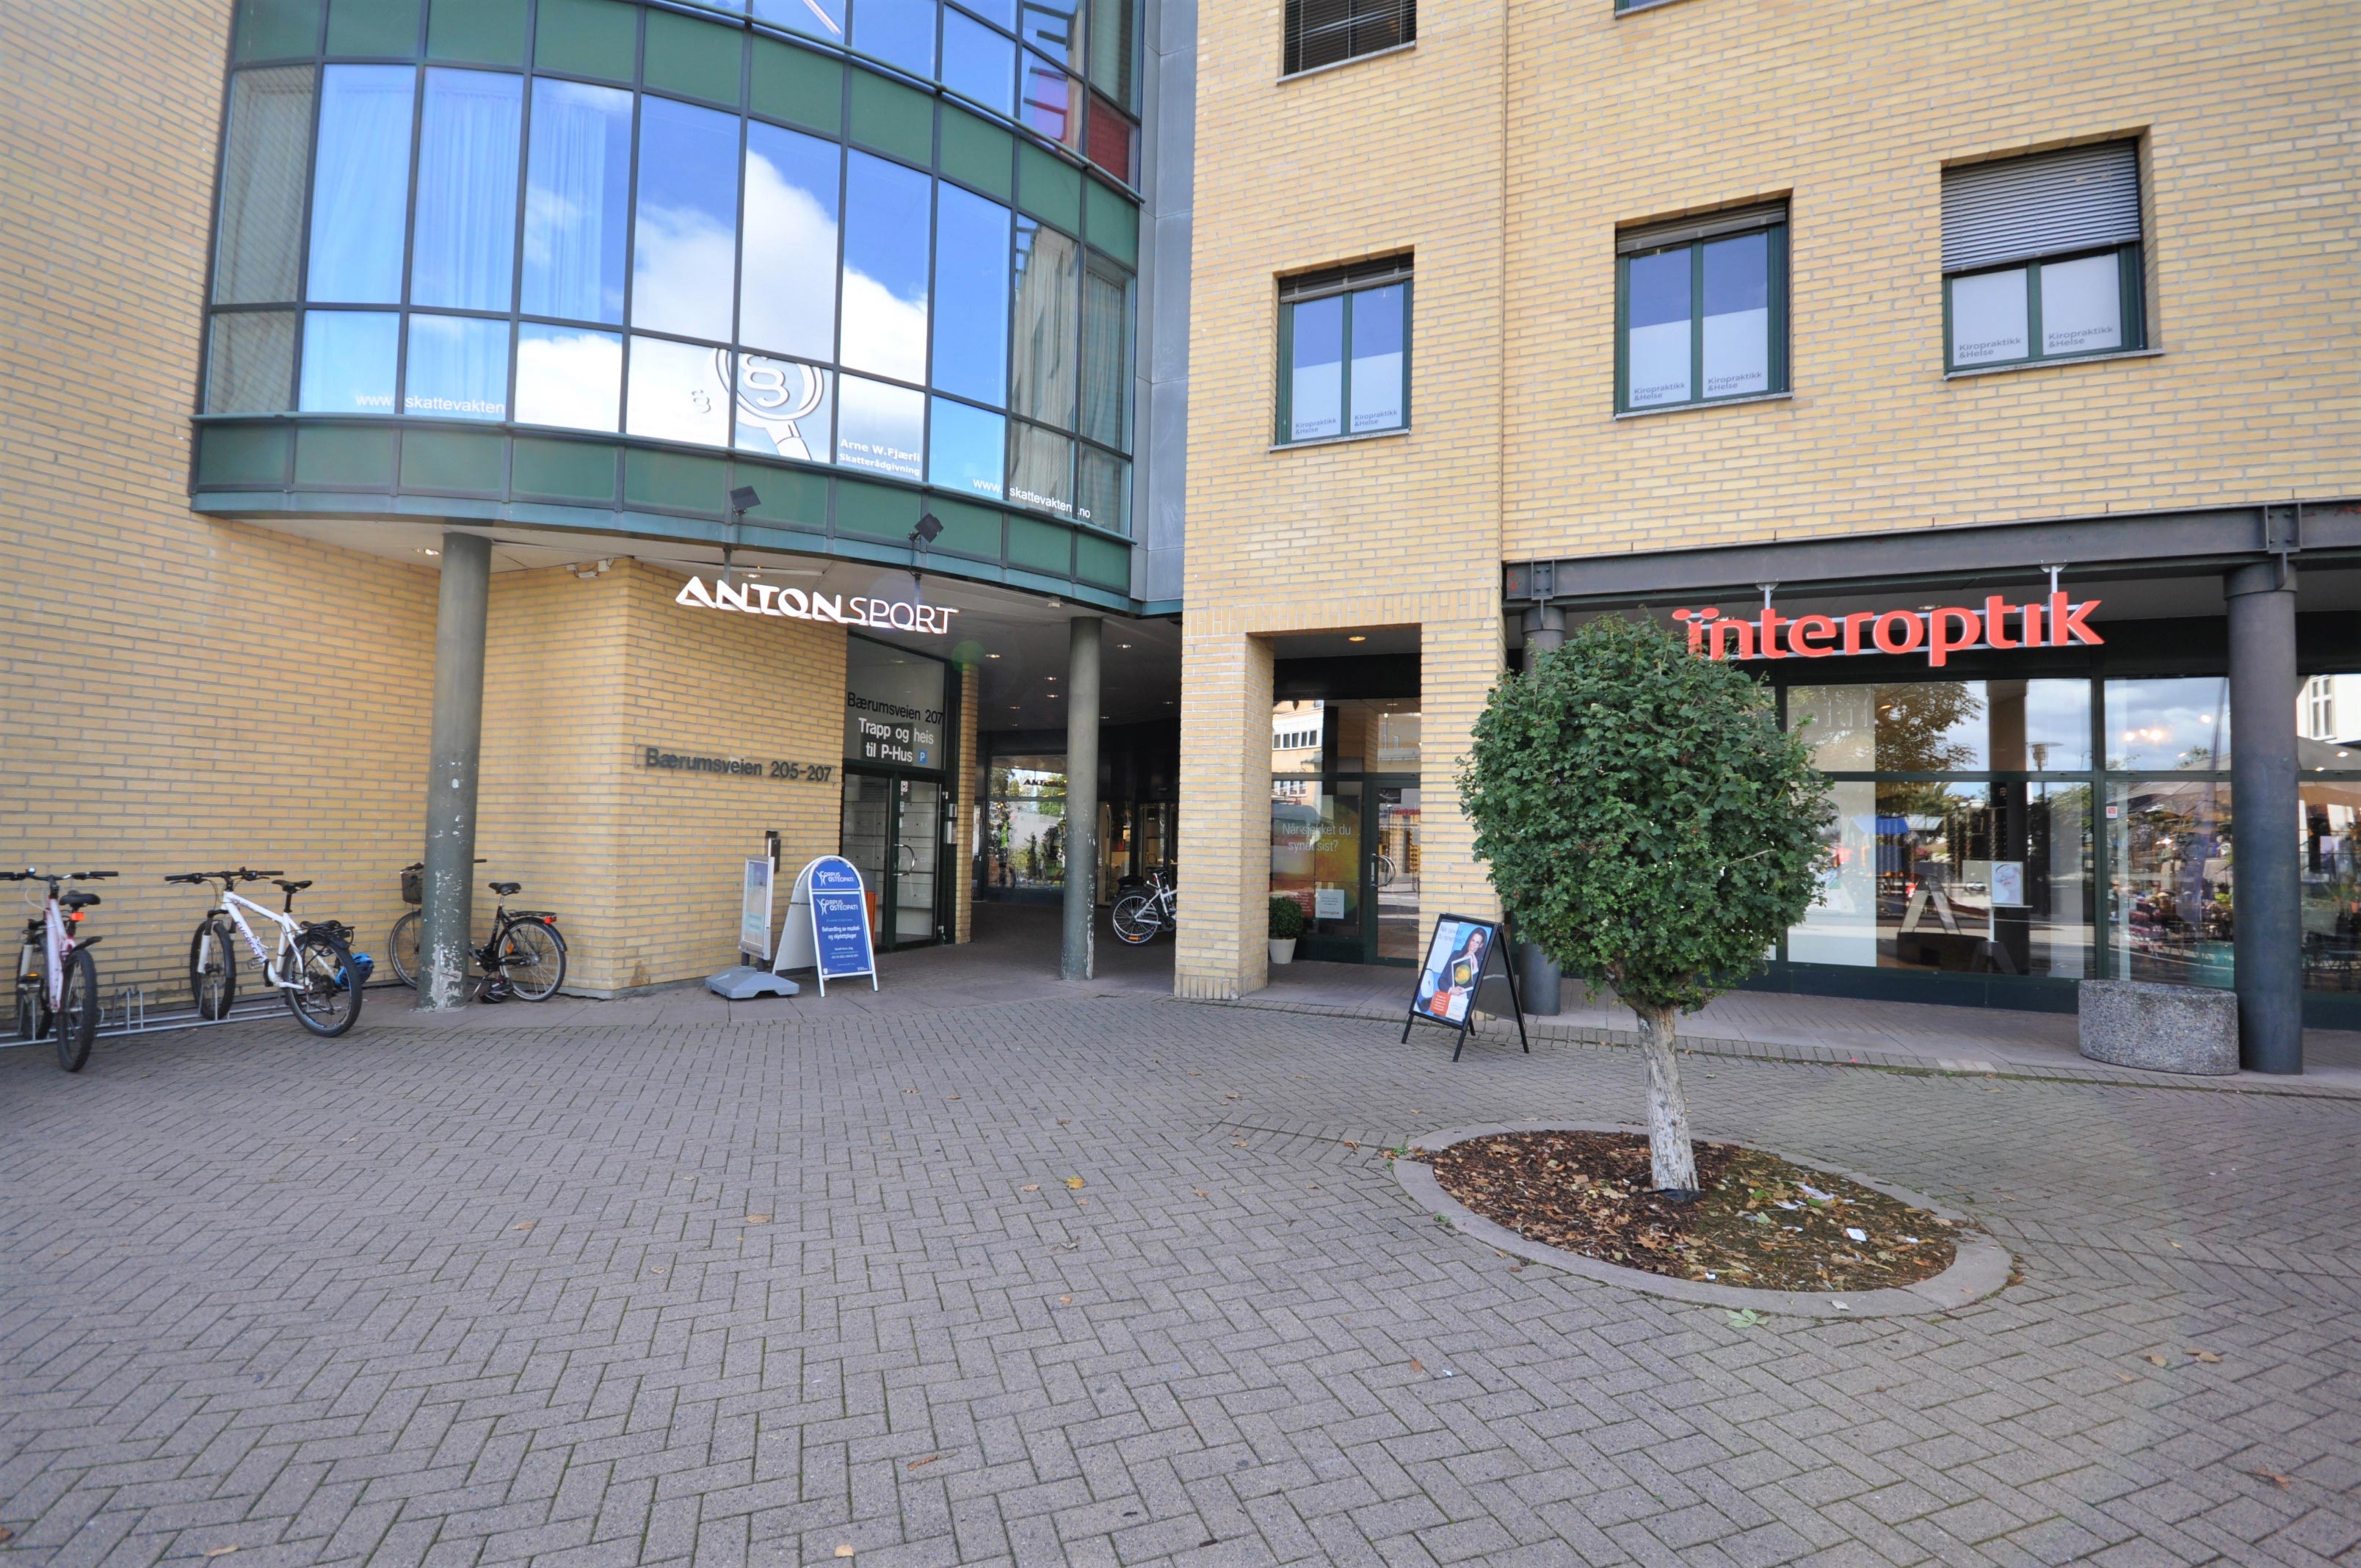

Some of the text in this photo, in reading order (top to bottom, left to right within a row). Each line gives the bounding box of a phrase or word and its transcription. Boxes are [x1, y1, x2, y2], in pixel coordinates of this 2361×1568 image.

[2048, 326, 2114, 341] Kiropraktikk
[1959, 337, 2022, 352] Kiropraktikk
[2048, 337, 2086, 348] &Helse
[1959, 347, 1994, 359] &Helse
[1708, 371, 1763, 386] Kiropraktikk
[1633, 382, 1686, 396] Kiropraktikk
[1708, 382, 1738, 392] &Helse
[405, 394, 506, 414] skattevakten
[1633, 392, 1663, 402] &Helse
[1354, 410, 1398, 422] Kiropraktikk
[1354, 418, 1379, 427] &Helse
[1295, 418, 1337, 430] Kiropraktikk
[1295, 426, 1319, 435] &Helse
[840, 438, 869, 452] Arne
[839, 453, 921, 476] Skatterådgivning
[972, 478, 1091, 518] www. skattevakten .no
[1672, 591, 2106, 667] interoptik
[847, 692, 944, 725] Bærumsveien 207
[858, 717, 935, 745] Trapp og heis
[866, 742, 913, 763] til P-Hus
[645, 747, 832, 783] Bærumsveien 205-207
[1283, 823, 1352, 837] Når sjekket du
[1317, 840, 1338, 852] sist?
